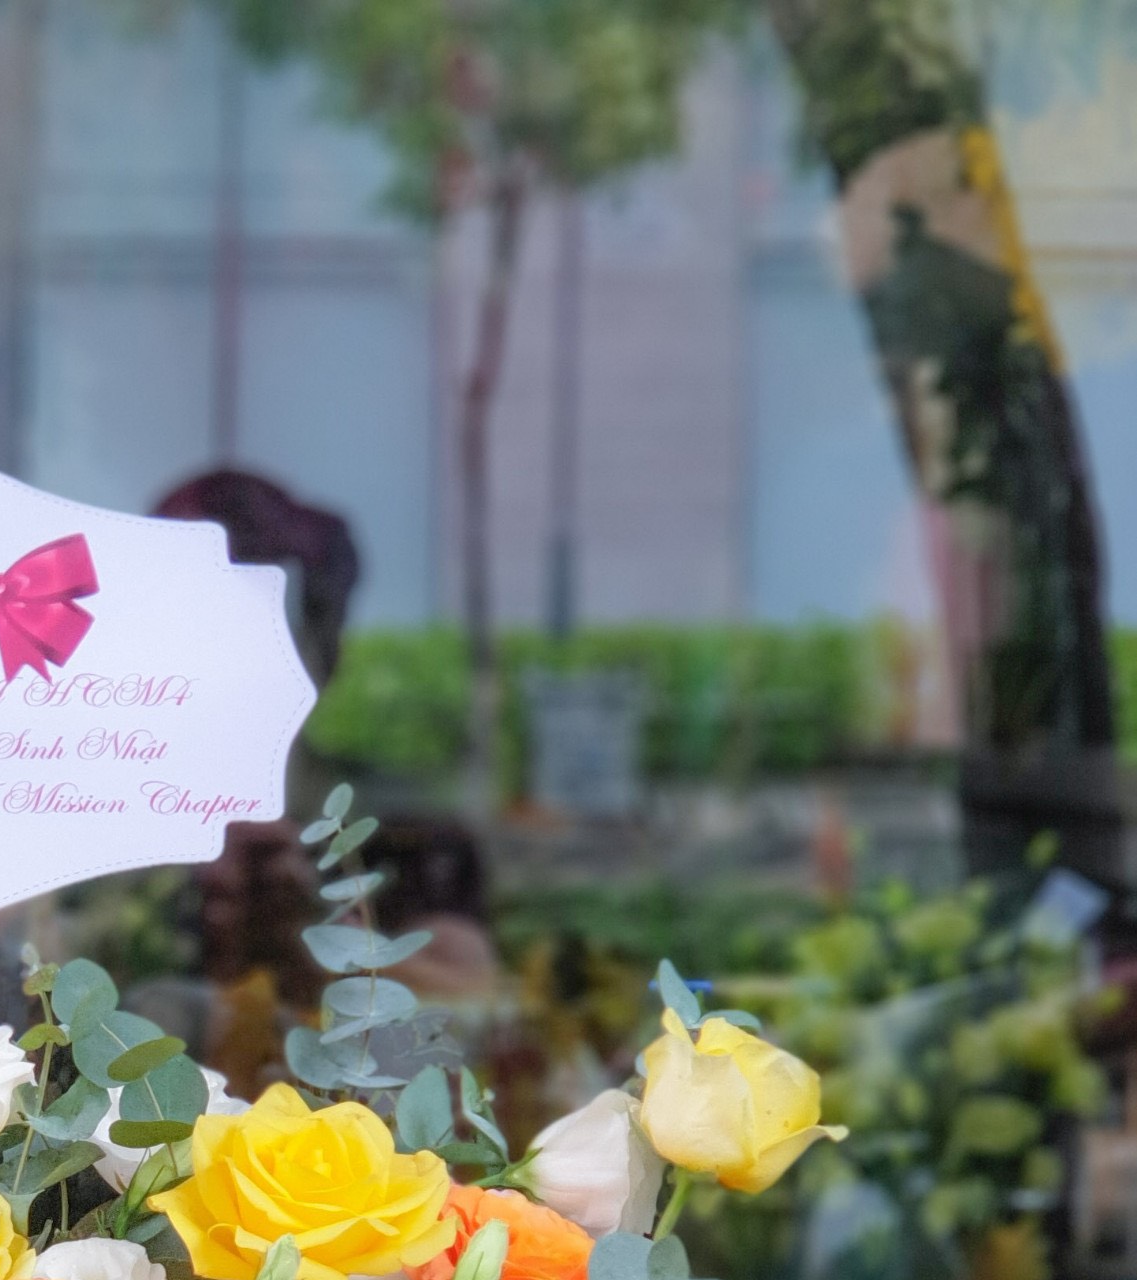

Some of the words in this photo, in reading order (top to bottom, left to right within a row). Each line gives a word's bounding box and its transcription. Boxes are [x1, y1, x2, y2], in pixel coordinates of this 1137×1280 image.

[24, 673, 199, 708] HCM4
[3, 780, 129, 814] Mission
[140, 780, 262, 824] Chapter
